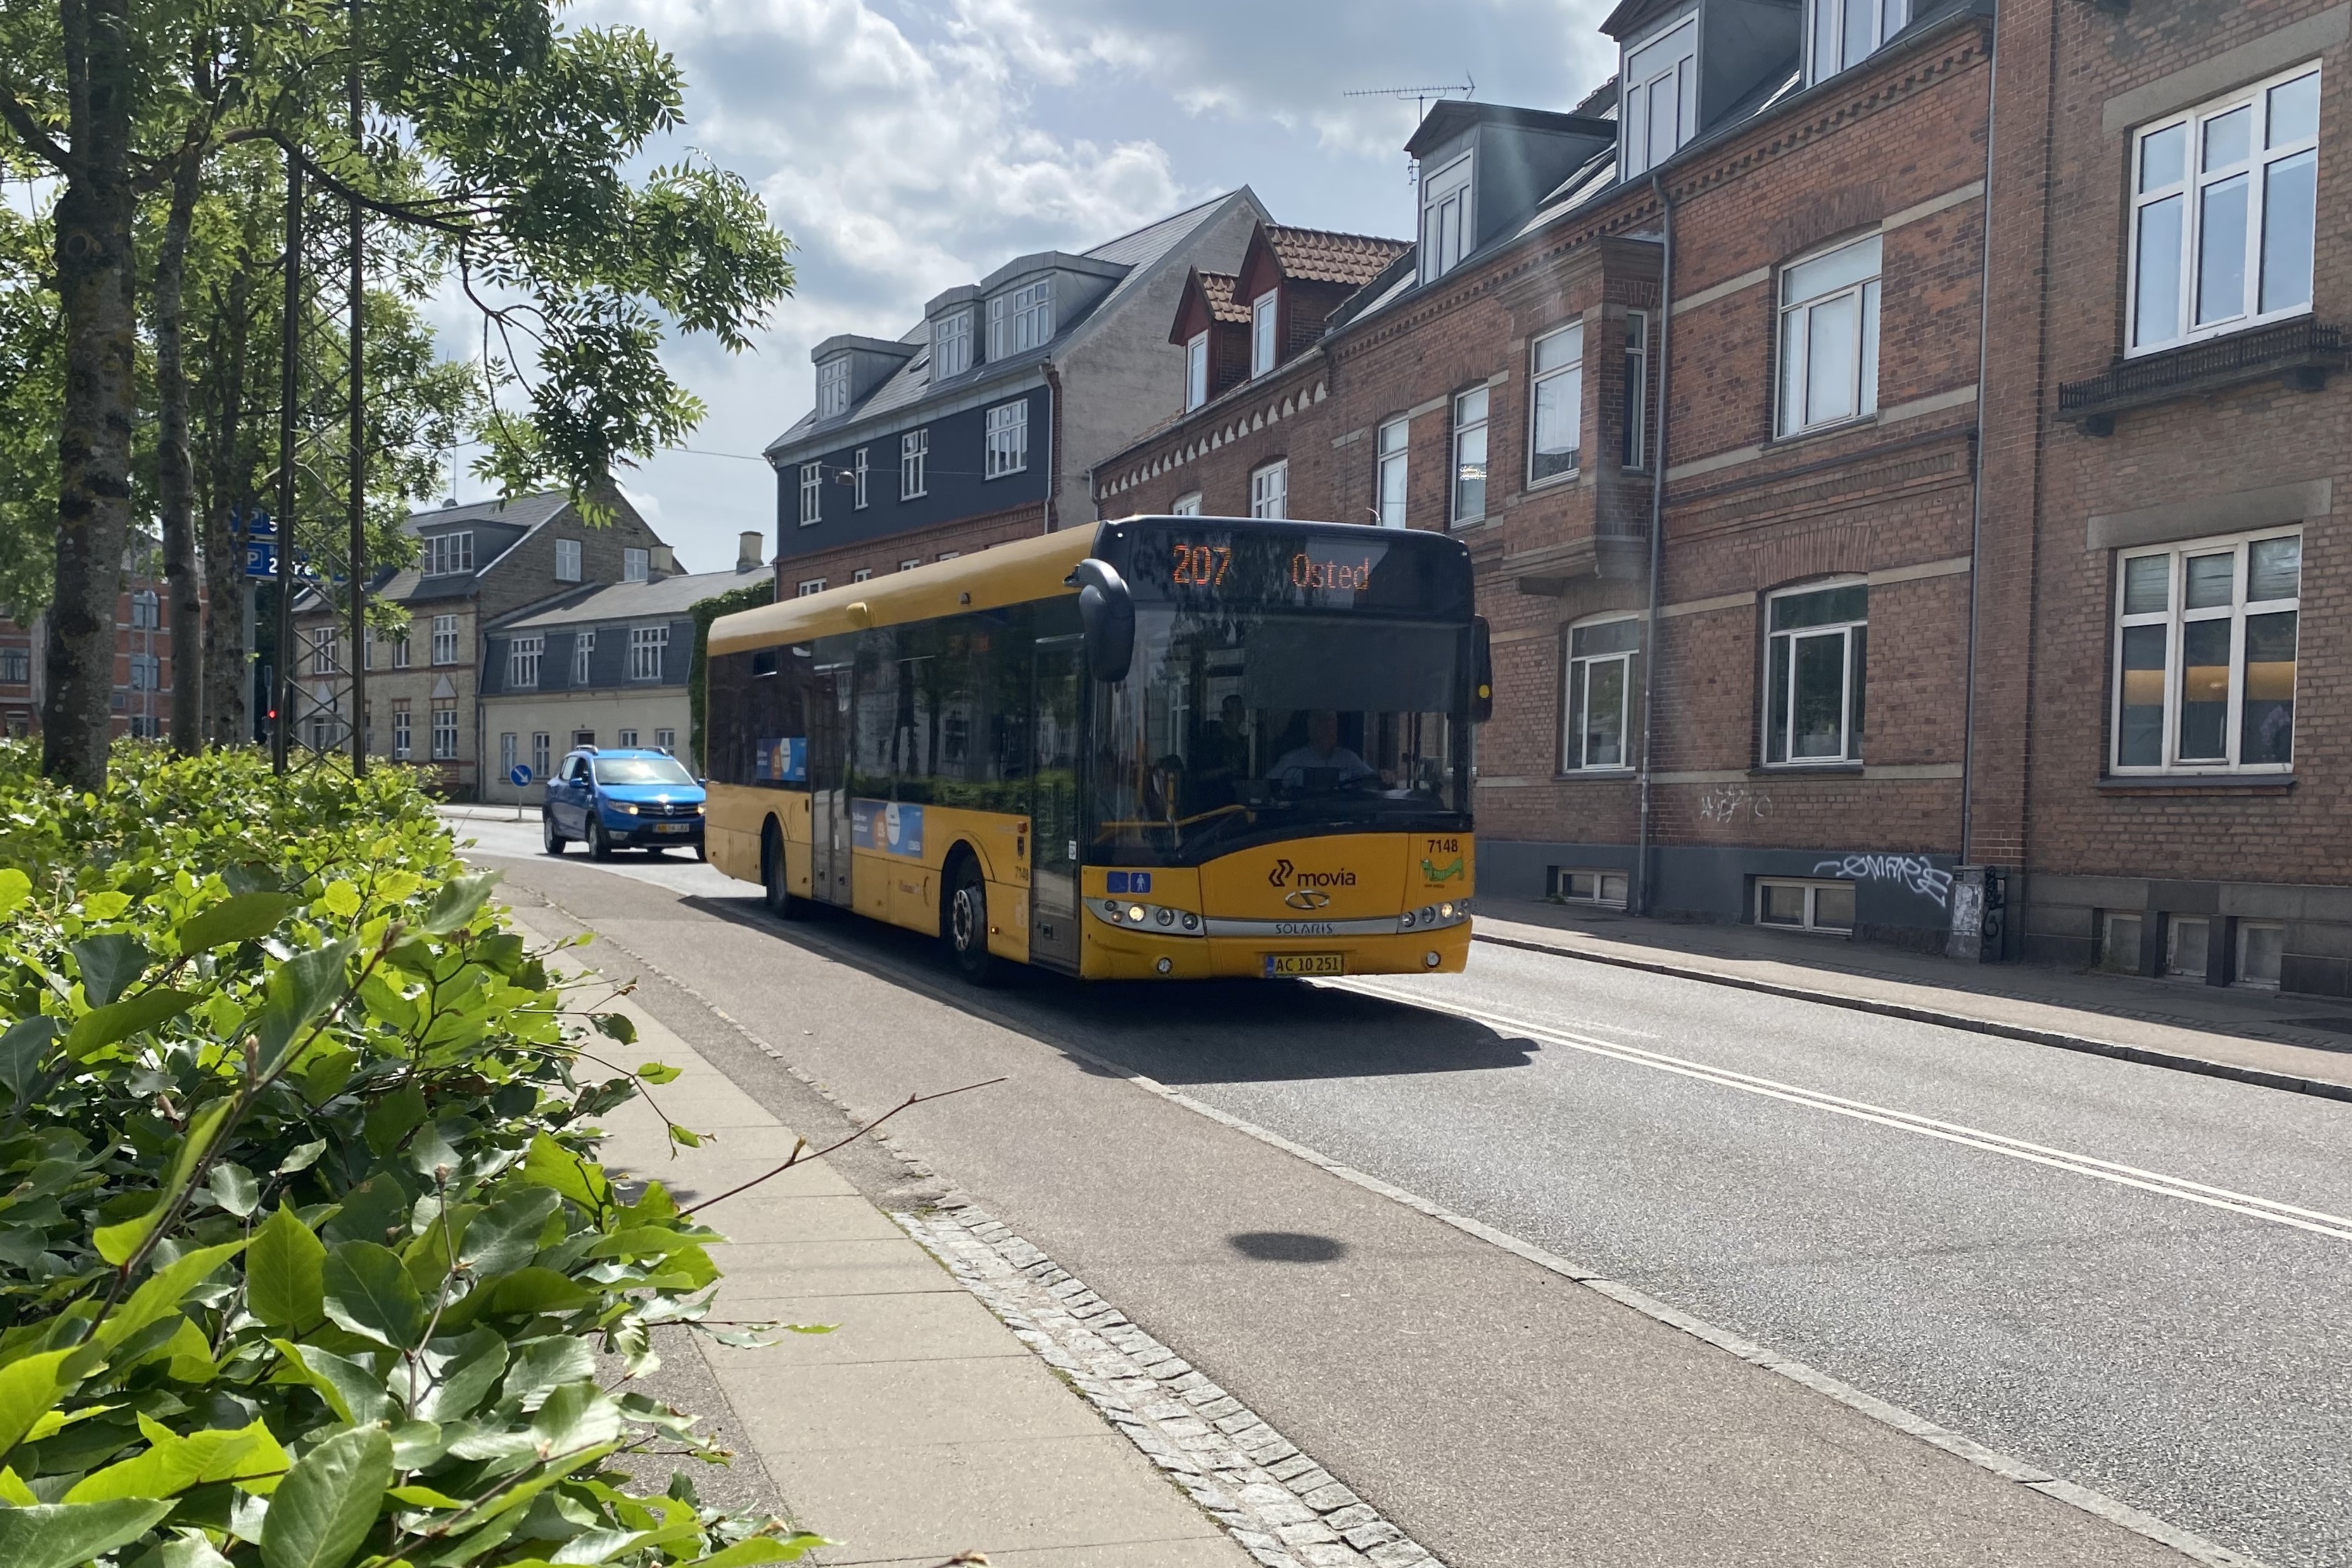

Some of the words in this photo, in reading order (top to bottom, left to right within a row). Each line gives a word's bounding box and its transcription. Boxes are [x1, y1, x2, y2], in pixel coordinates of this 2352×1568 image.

[1173, 543, 1232, 586] 207
[1292, 552, 1369, 590] Osted
[1427, 838, 1459, 854] 7148
[1297, 867, 1357, 887] movia
[1275, 923, 1333, 935] SOLARIS
[1275, 958, 1294, 972] AC
[1298, 958, 1313, 971] 10
[1316, 957, 1339, 971] 251
